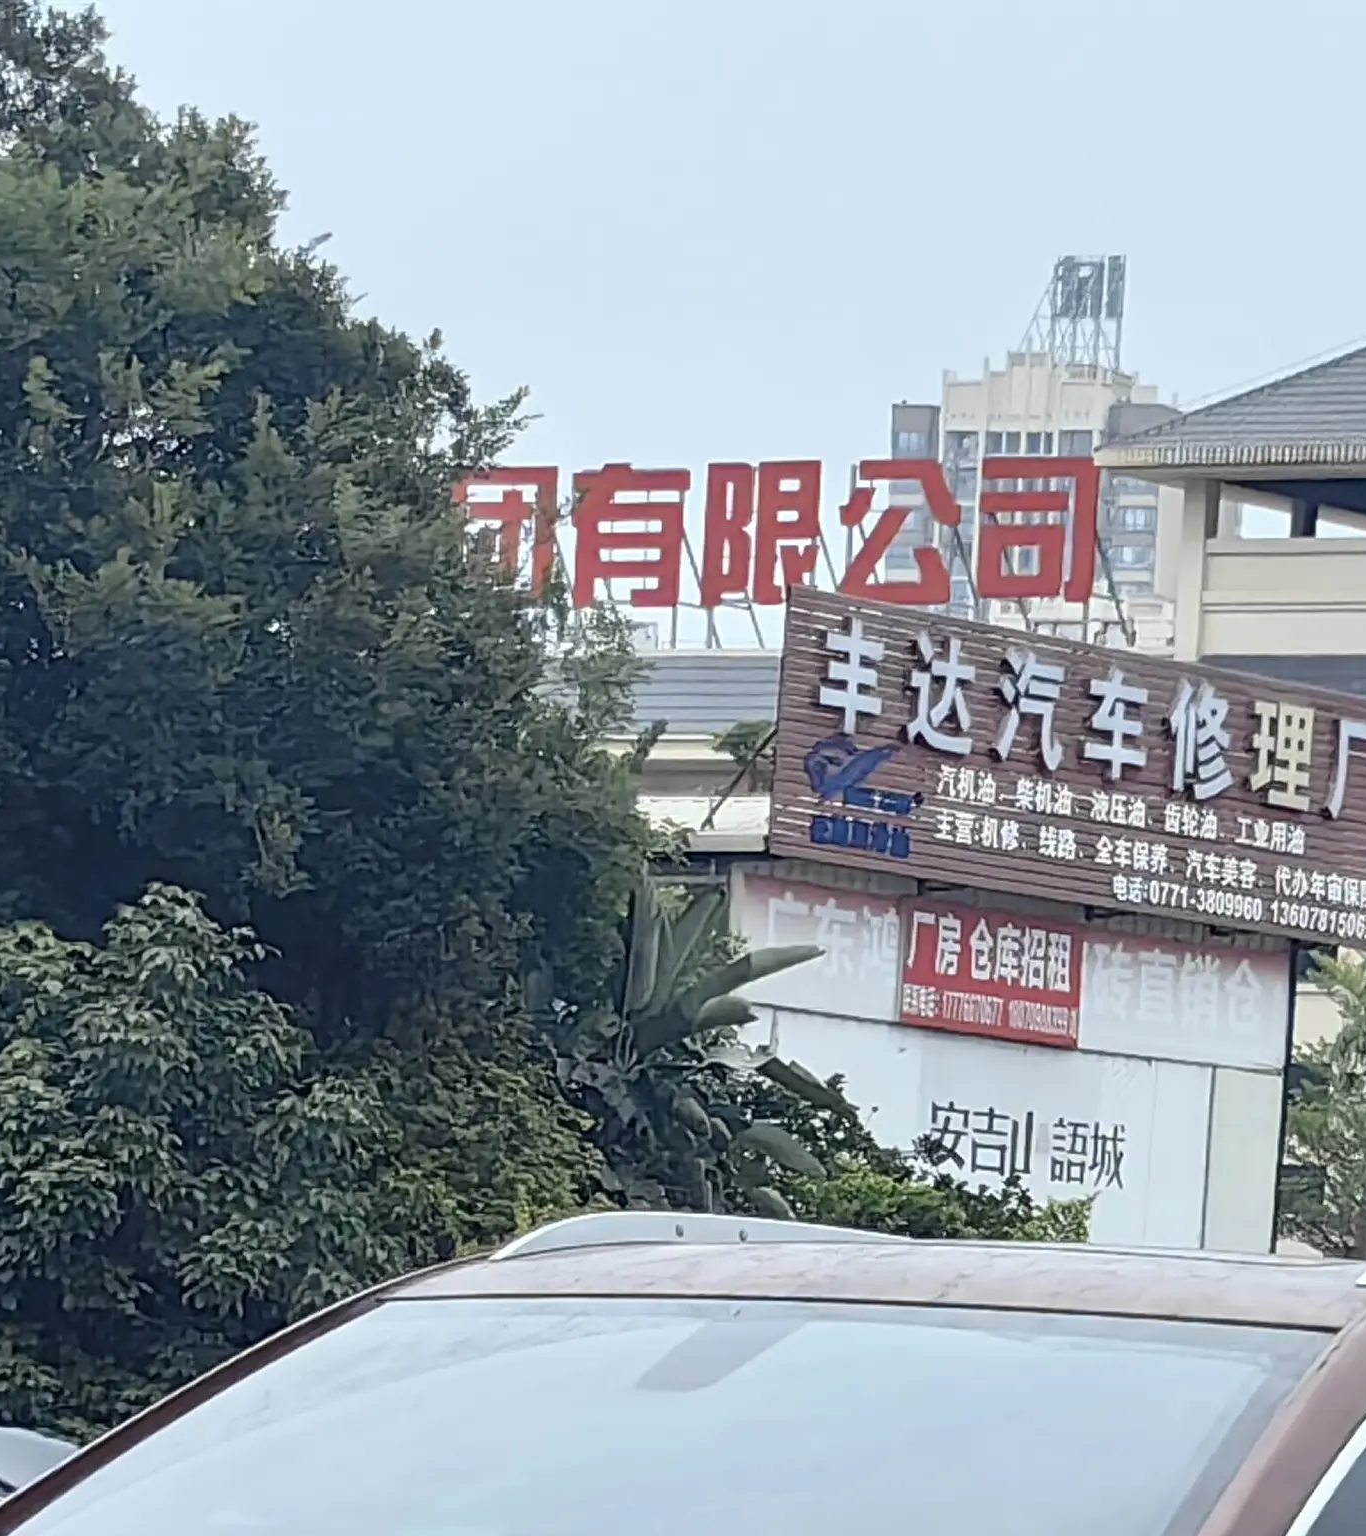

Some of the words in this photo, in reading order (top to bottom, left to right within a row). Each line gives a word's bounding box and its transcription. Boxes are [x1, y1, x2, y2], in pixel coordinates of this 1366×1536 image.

[906, 909, 963, 977] 厂房
[969, 916, 1073, 994] 仓库招租
